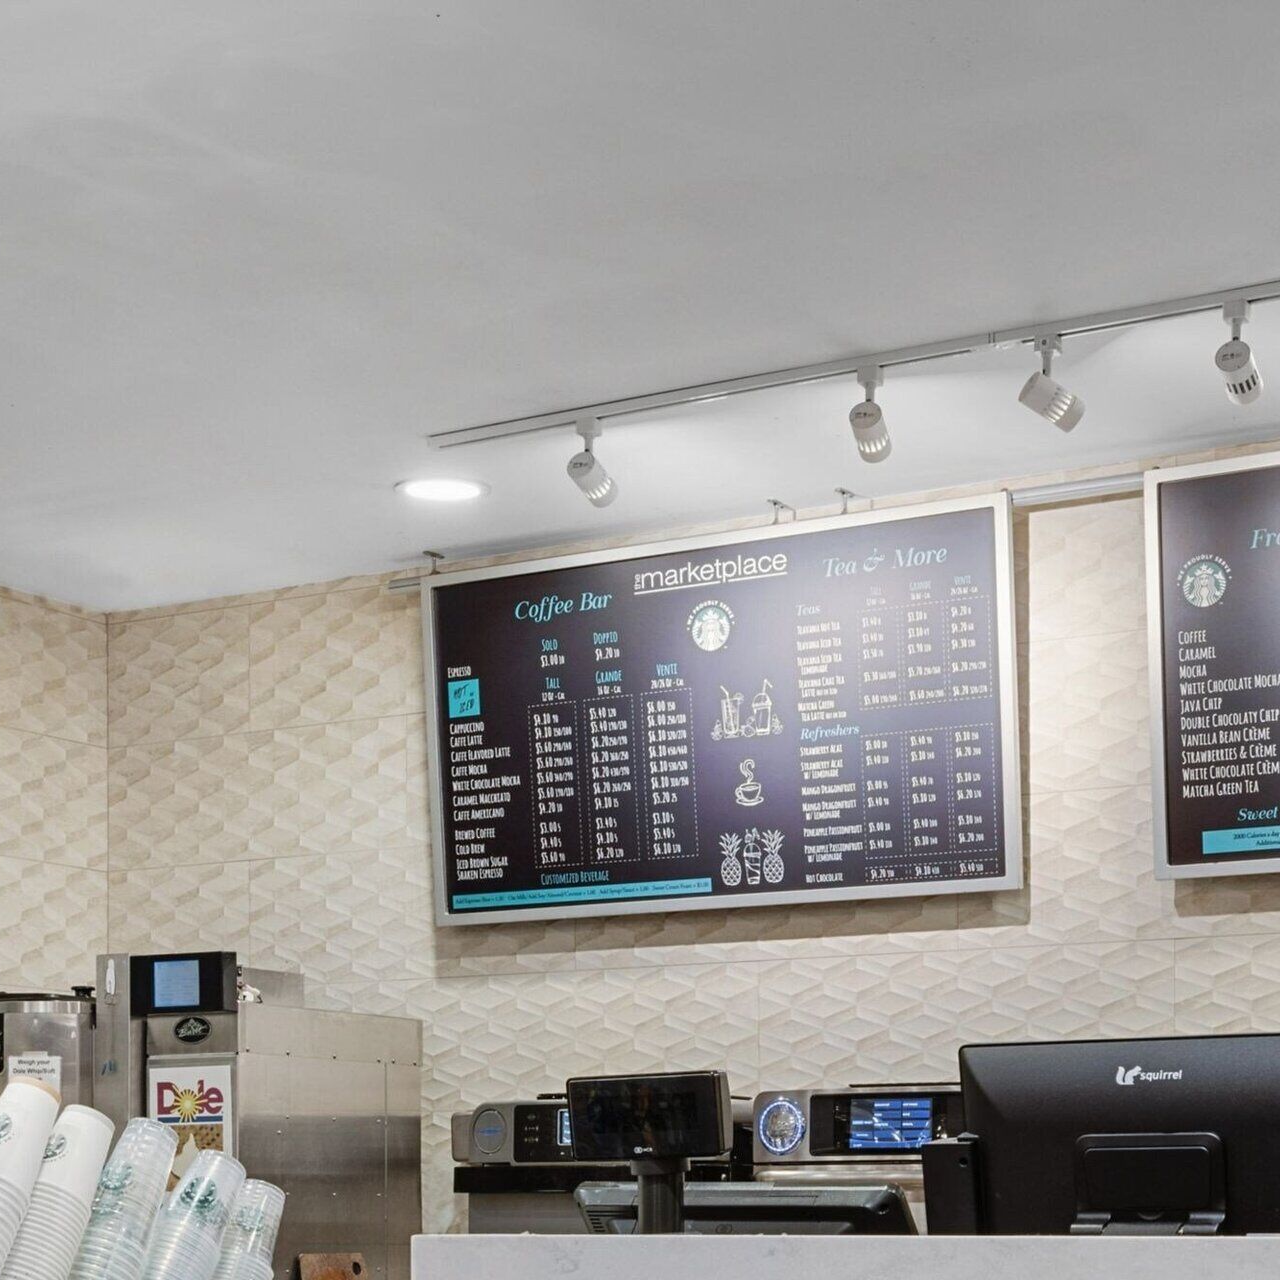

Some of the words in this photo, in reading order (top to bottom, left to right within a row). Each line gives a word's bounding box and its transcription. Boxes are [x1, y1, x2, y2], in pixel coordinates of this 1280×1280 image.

[824, 558, 857, 577] Tea
[863, 548, 885, 572] &
[892, 547, 947, 569] More
[641, 553, 787, 590] marketplace
[515, 596, 574, 622] Coffee
[580, 591, 612, 611] Bar
[593, 631, 618, 645] DOPPIO
[1178, 630, 1206, 644] COFFEE
[541, 638, 558, 652] SOLO
[1179, 647, 1216, 661] CARAMEL
[595, 669, 622, 684] GRANDE
[656, 663, 678, 676] VENTI
[1179, 665, 1207, 679] MOCHA
[545, 677, 560, 690] TALL
[1180, 681, 1205, 696] WHITE
[1207, 677, 1252, 694] CHOCOLATE
[1180, 700, 1201, 714] JAVA
[1202, 697, 1223, 711] CHIP
[1180, 715, 1210, 730] DOUBLE
[1212, 711, 1258, 728] CHOCOLATY
[1259, 709, 1280, 722] CHIP
[450, 721, 484, 735] CAPPUCCINO
[800, 724, 860, 742] Refreshers
[1181, 731, 1218, 747] VANILLA
[1219, 730, 1240, 744] BEAN
[1182, 783, 1214, 799] MATCHA
[1216, 781, 1243, 796] GREEN
[1244, 780, 1259, 794] TEA
[1237, 808, 1278, 821] Sweet
[456, 844, 470, 855] COLD
[1140, 1069, 1183, 1082] squirrel
[157, 1080, 224, 1115] Dole
